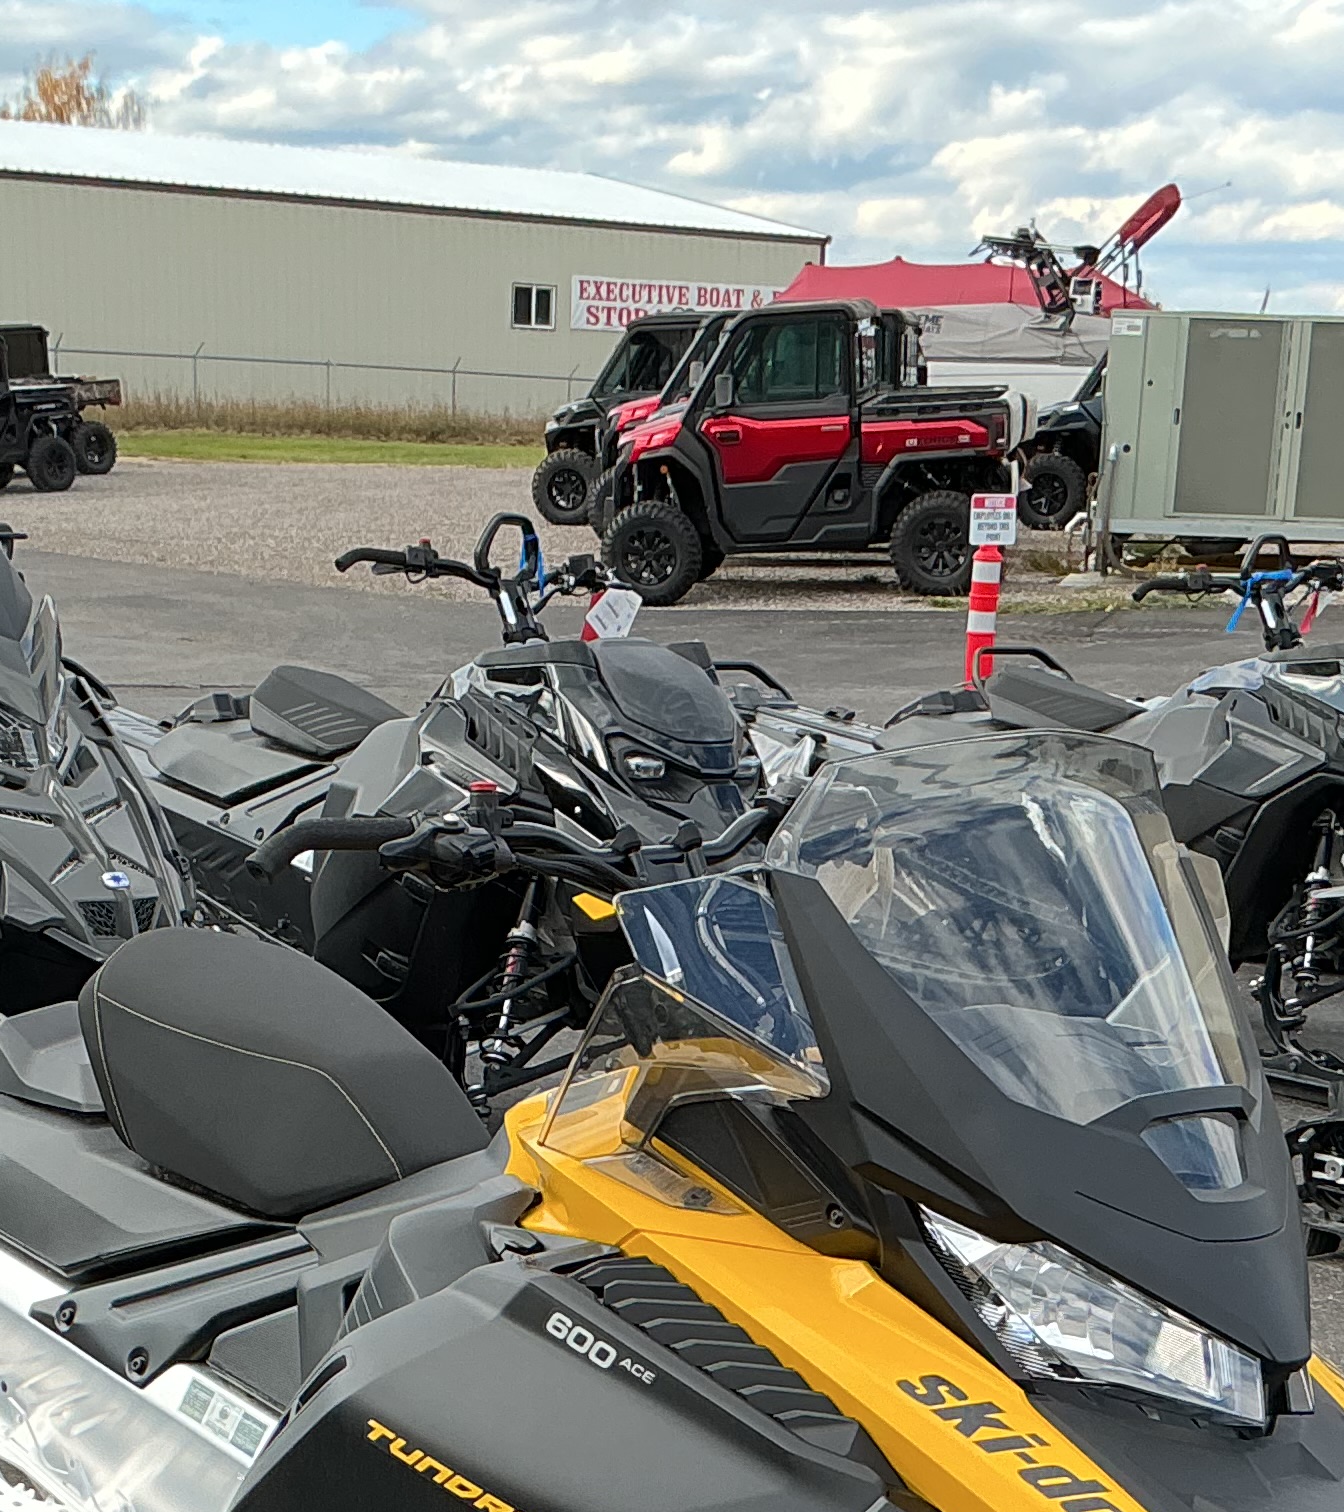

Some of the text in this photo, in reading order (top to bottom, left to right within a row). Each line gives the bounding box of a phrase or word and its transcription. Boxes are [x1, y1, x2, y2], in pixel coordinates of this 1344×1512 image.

[578, 279, 690, 306] EXECUTIVE
[696, 286, 744, 309] BOAT
[752, 289, 763, 309] &
[546, 1311, 656, 1385] 600 ACE
